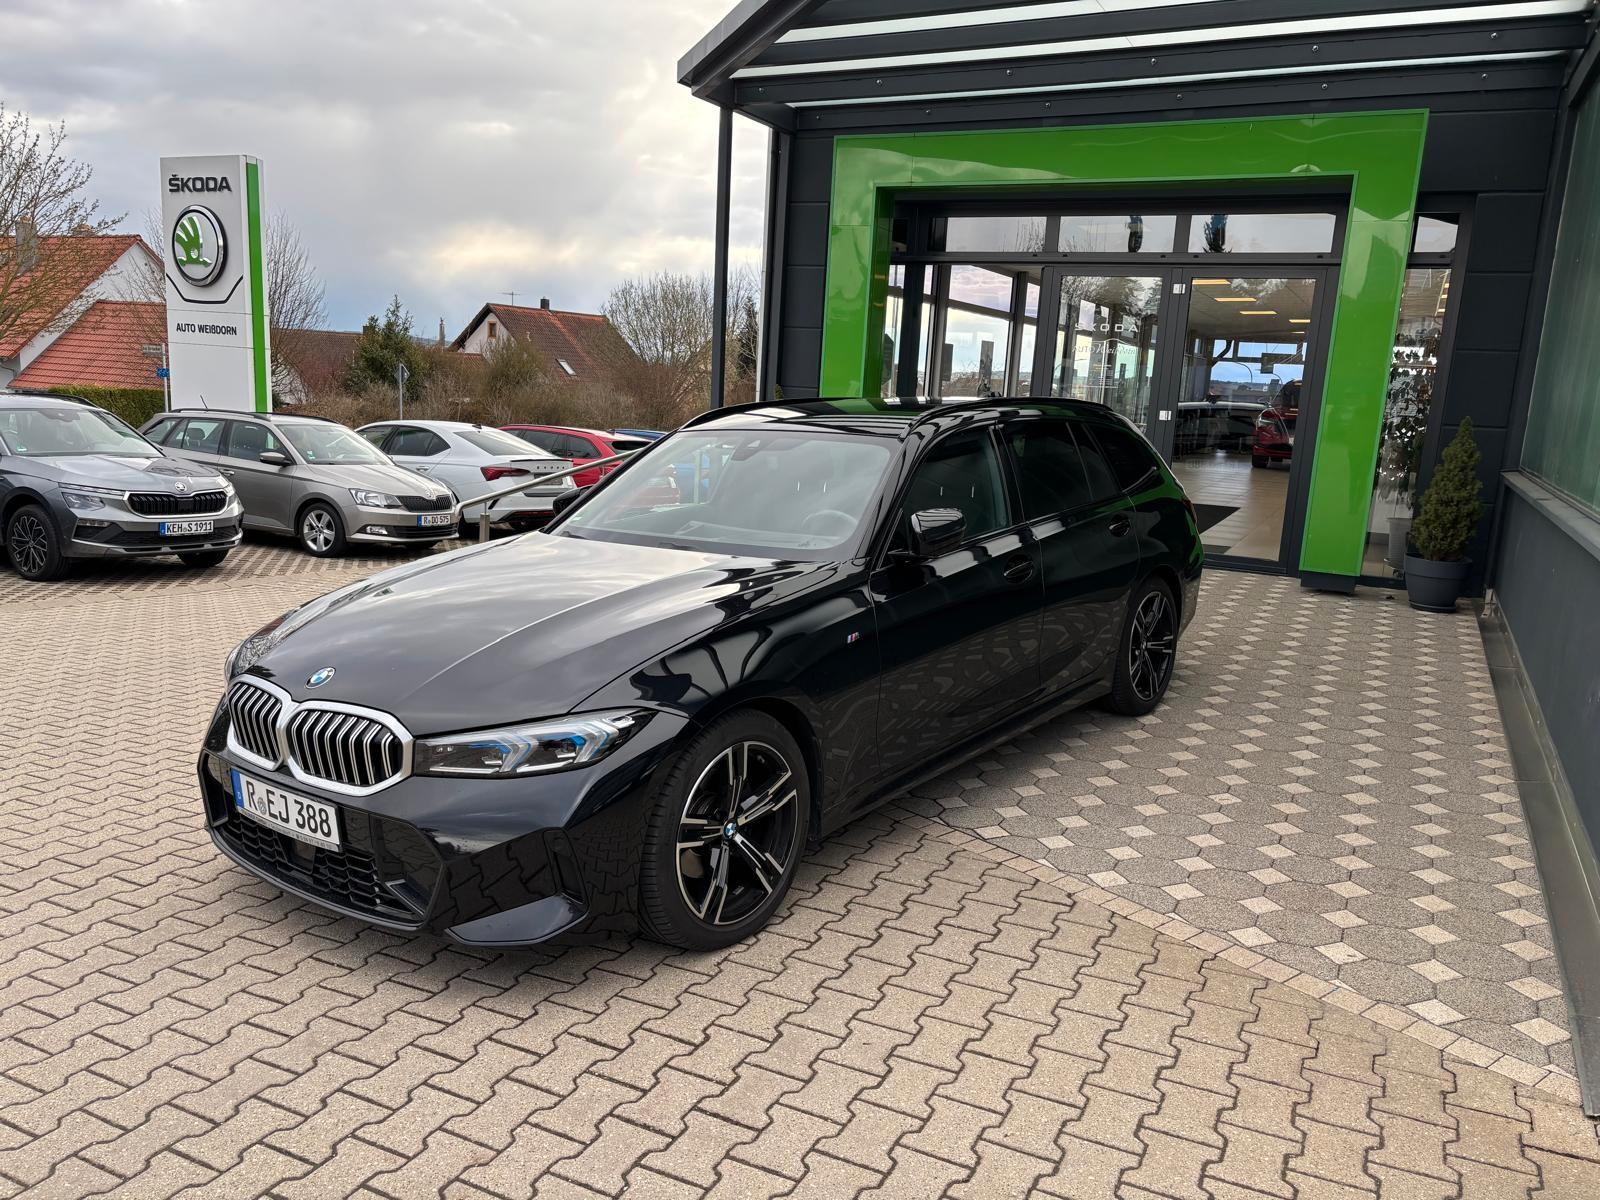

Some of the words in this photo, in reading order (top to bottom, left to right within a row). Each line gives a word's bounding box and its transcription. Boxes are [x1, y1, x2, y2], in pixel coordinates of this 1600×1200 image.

[168, 173, 233, 193] ŠKODA
[176, 322, 196, 334] AUTO
[166, 523, 183, 534] KEH
[187, 522, 193, 532] S
[194, 521, 213, 532] 1911
[246, 780, 258, 811] R
[266, 788, 290, 824] EJ
[294, 799, 332, 838] 388
